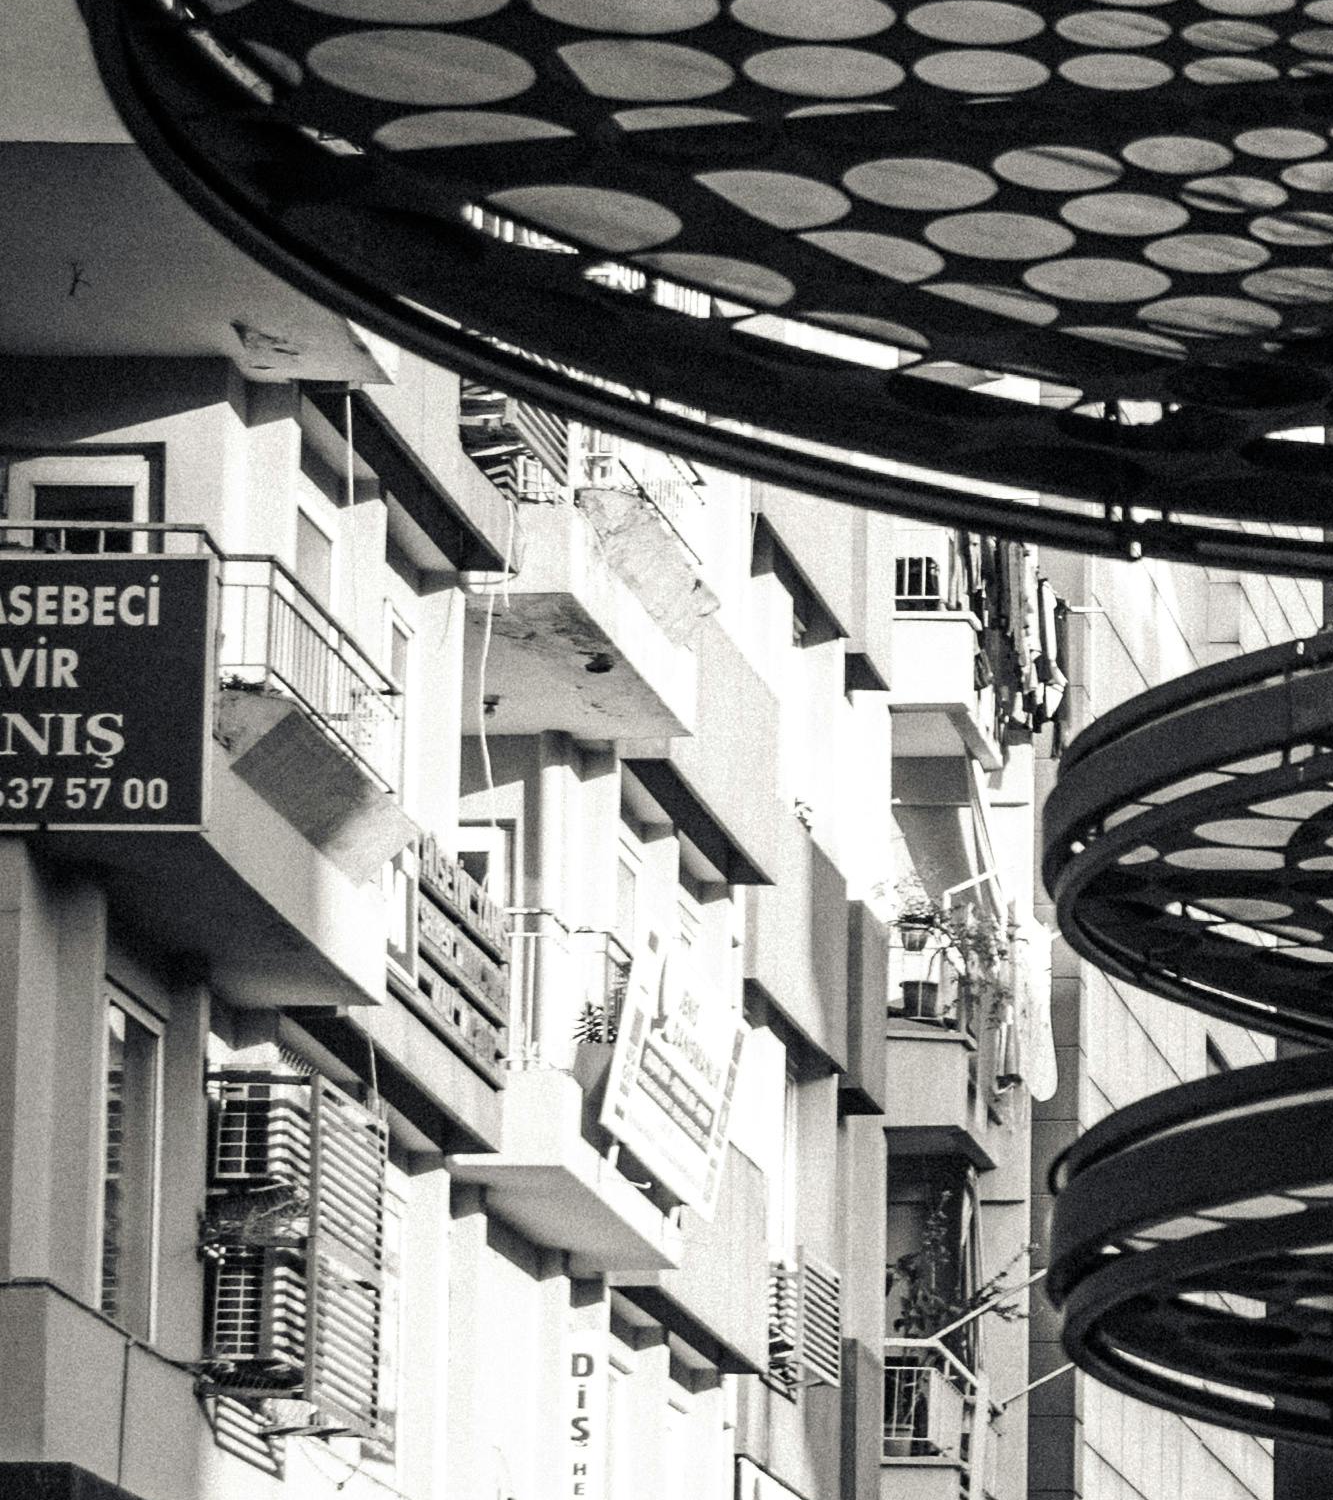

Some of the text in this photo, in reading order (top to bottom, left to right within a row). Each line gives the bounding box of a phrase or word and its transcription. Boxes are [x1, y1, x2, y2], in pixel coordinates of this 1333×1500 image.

[2, 713, 125, 768] NIŞ
[0, 777, 168, 810] 37 57 00
[569, 1352, 595, 1447] DİŞ
